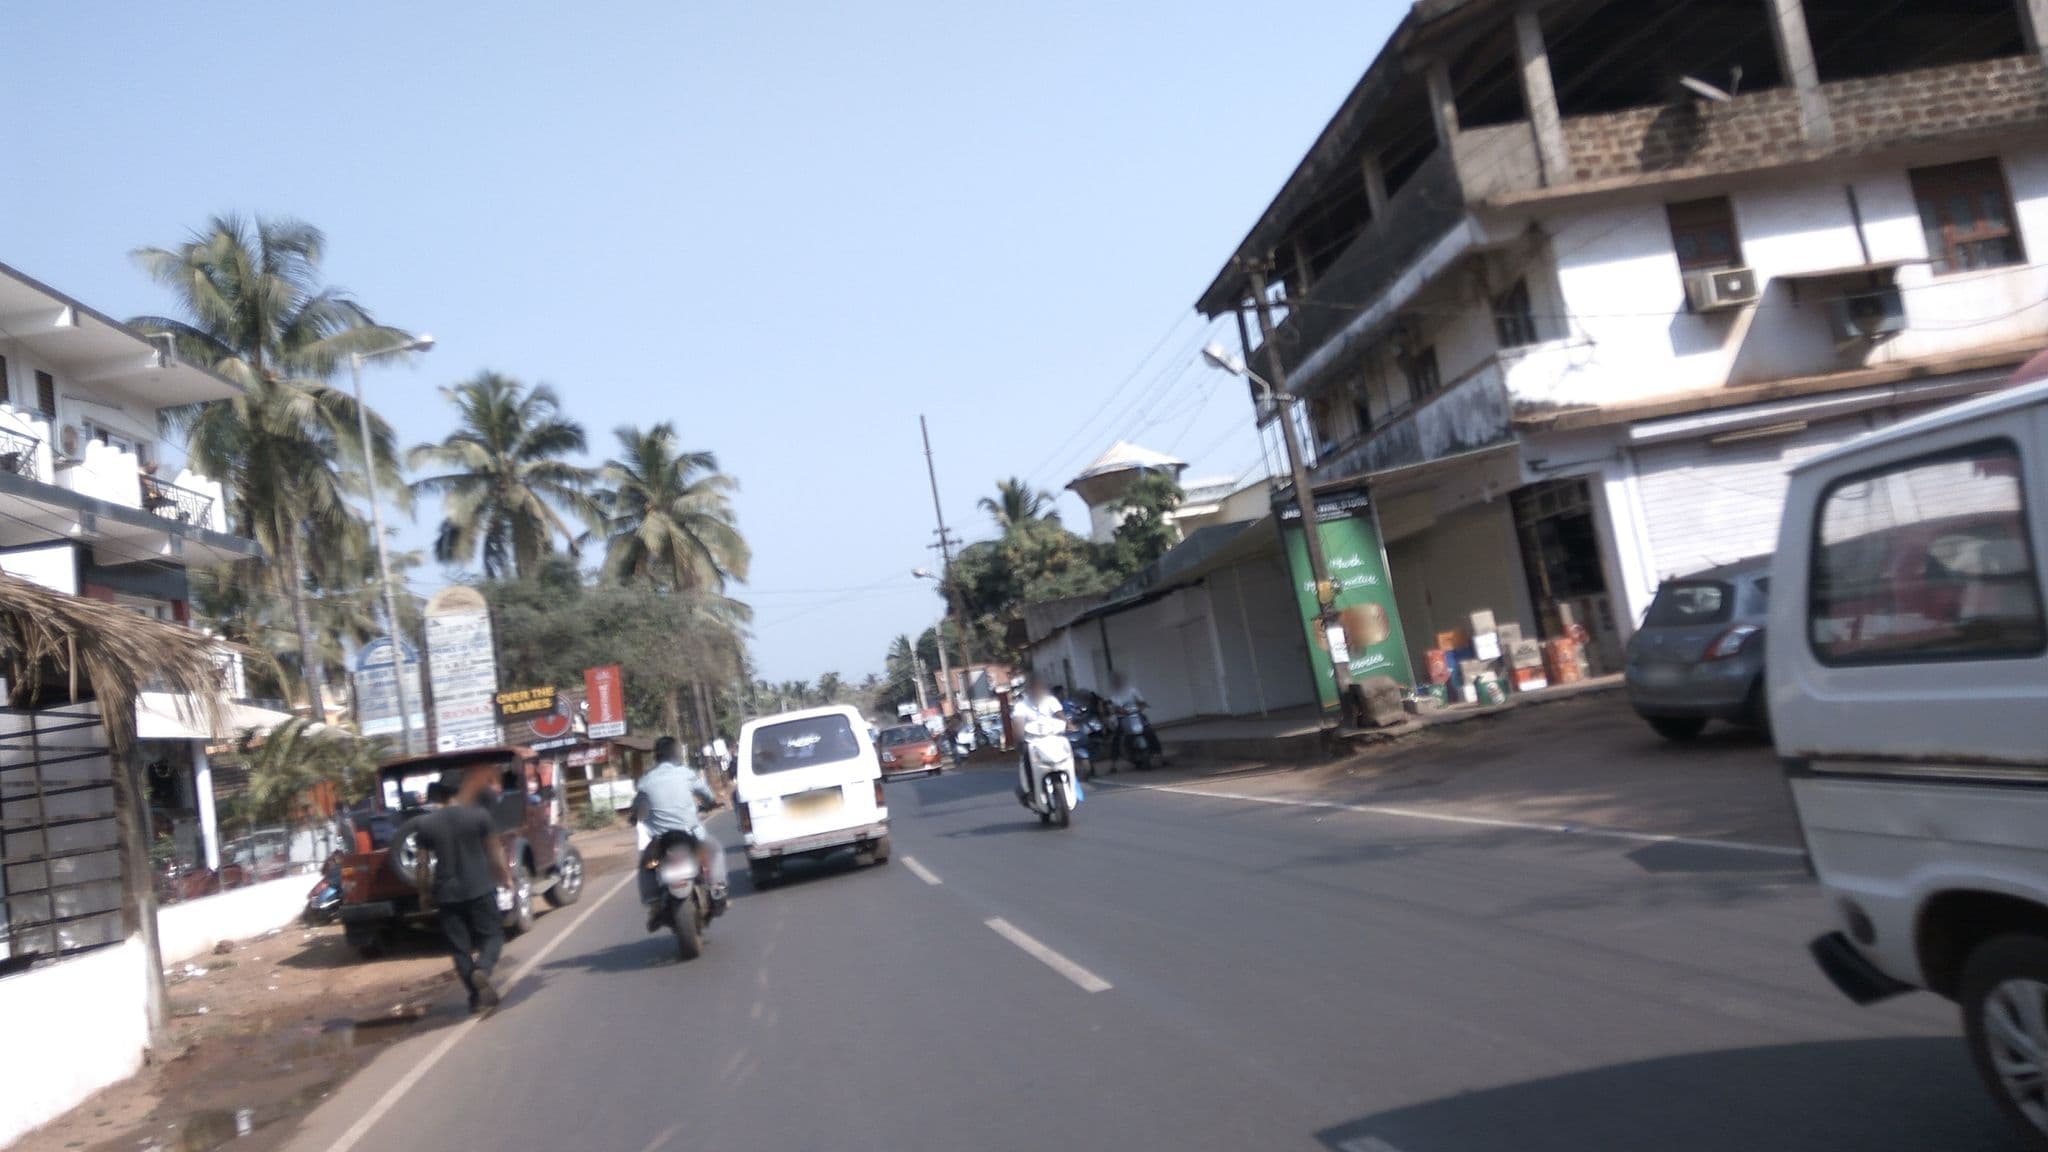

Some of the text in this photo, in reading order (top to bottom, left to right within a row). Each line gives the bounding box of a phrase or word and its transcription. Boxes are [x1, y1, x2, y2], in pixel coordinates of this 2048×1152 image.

[496, 690, 530, 704] OVER
[532, 686, 556, 699] THE
[503, 698, 553, 714] FLAMES
